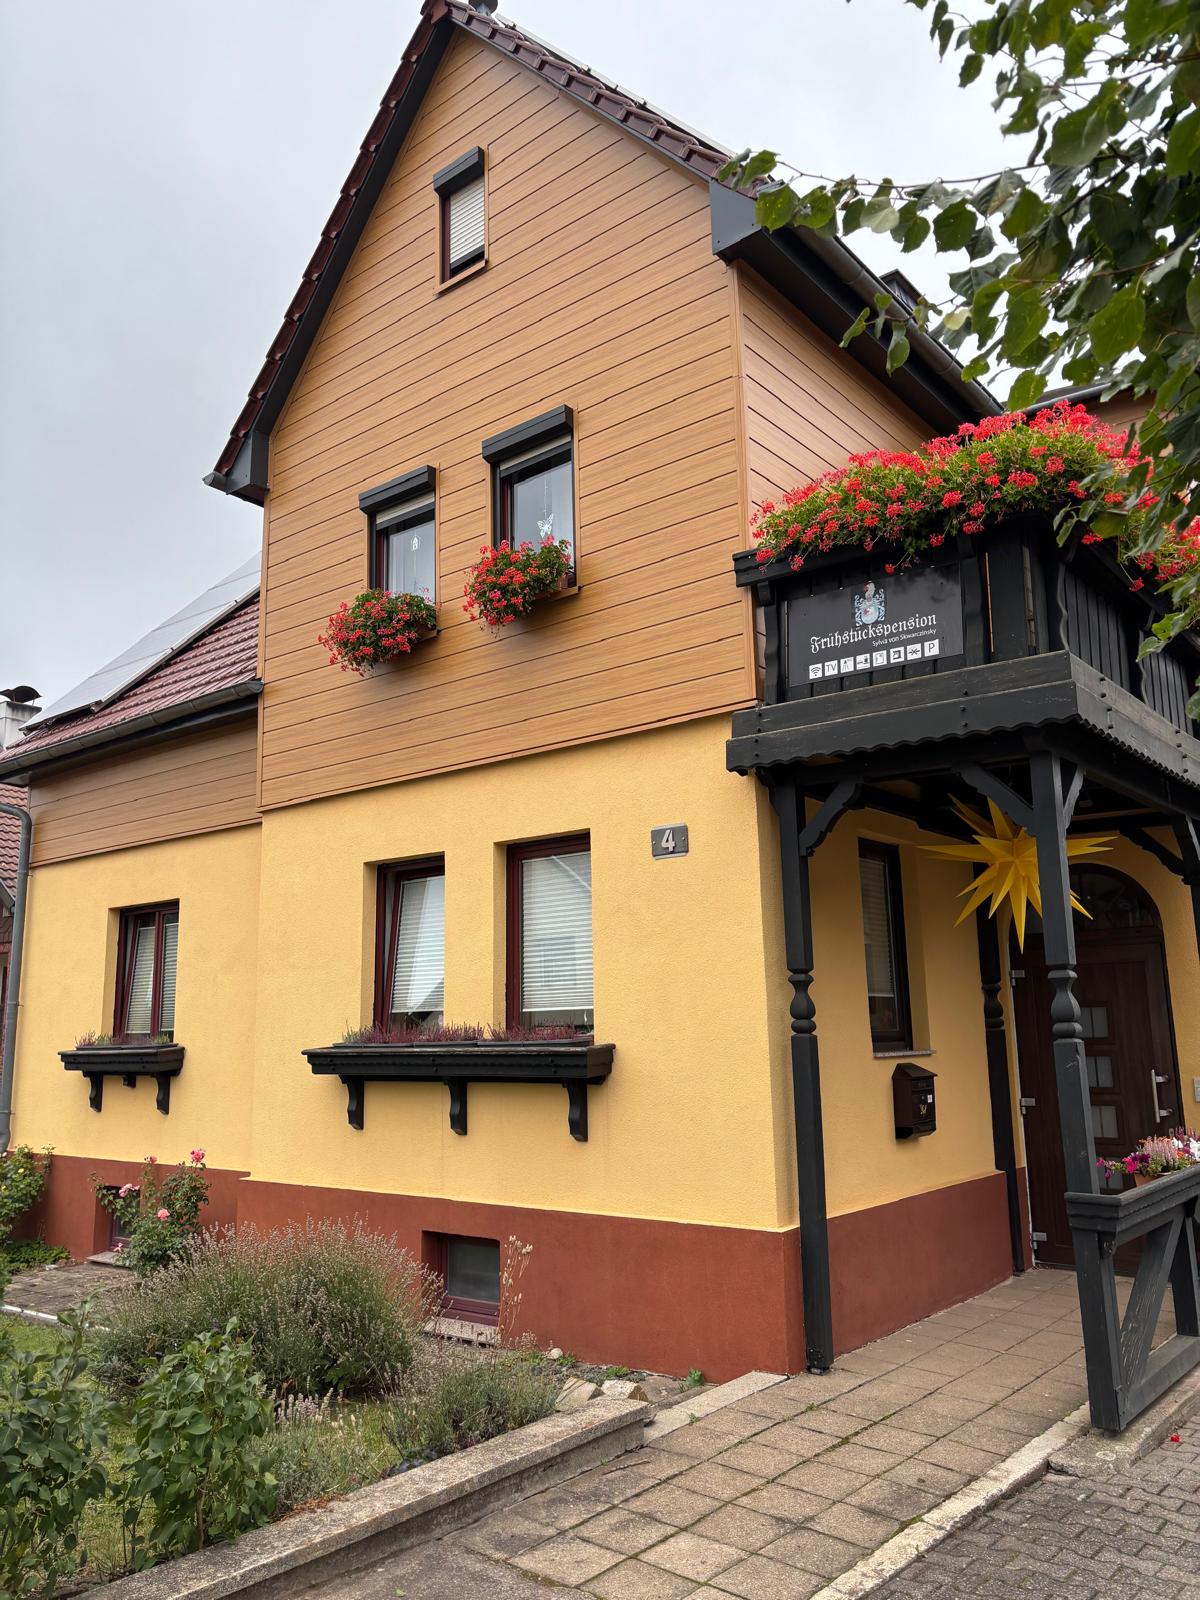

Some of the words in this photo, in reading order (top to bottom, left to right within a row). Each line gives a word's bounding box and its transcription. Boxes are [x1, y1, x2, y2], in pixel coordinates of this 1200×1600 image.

[811, 613, 937, 654] Frühstückspension
[872, 638, 888, 647] Sylvia
[928, 642, 935, 653] P
[826, 663, 837, 672] TV
[661, 829, 676, 852] 4
